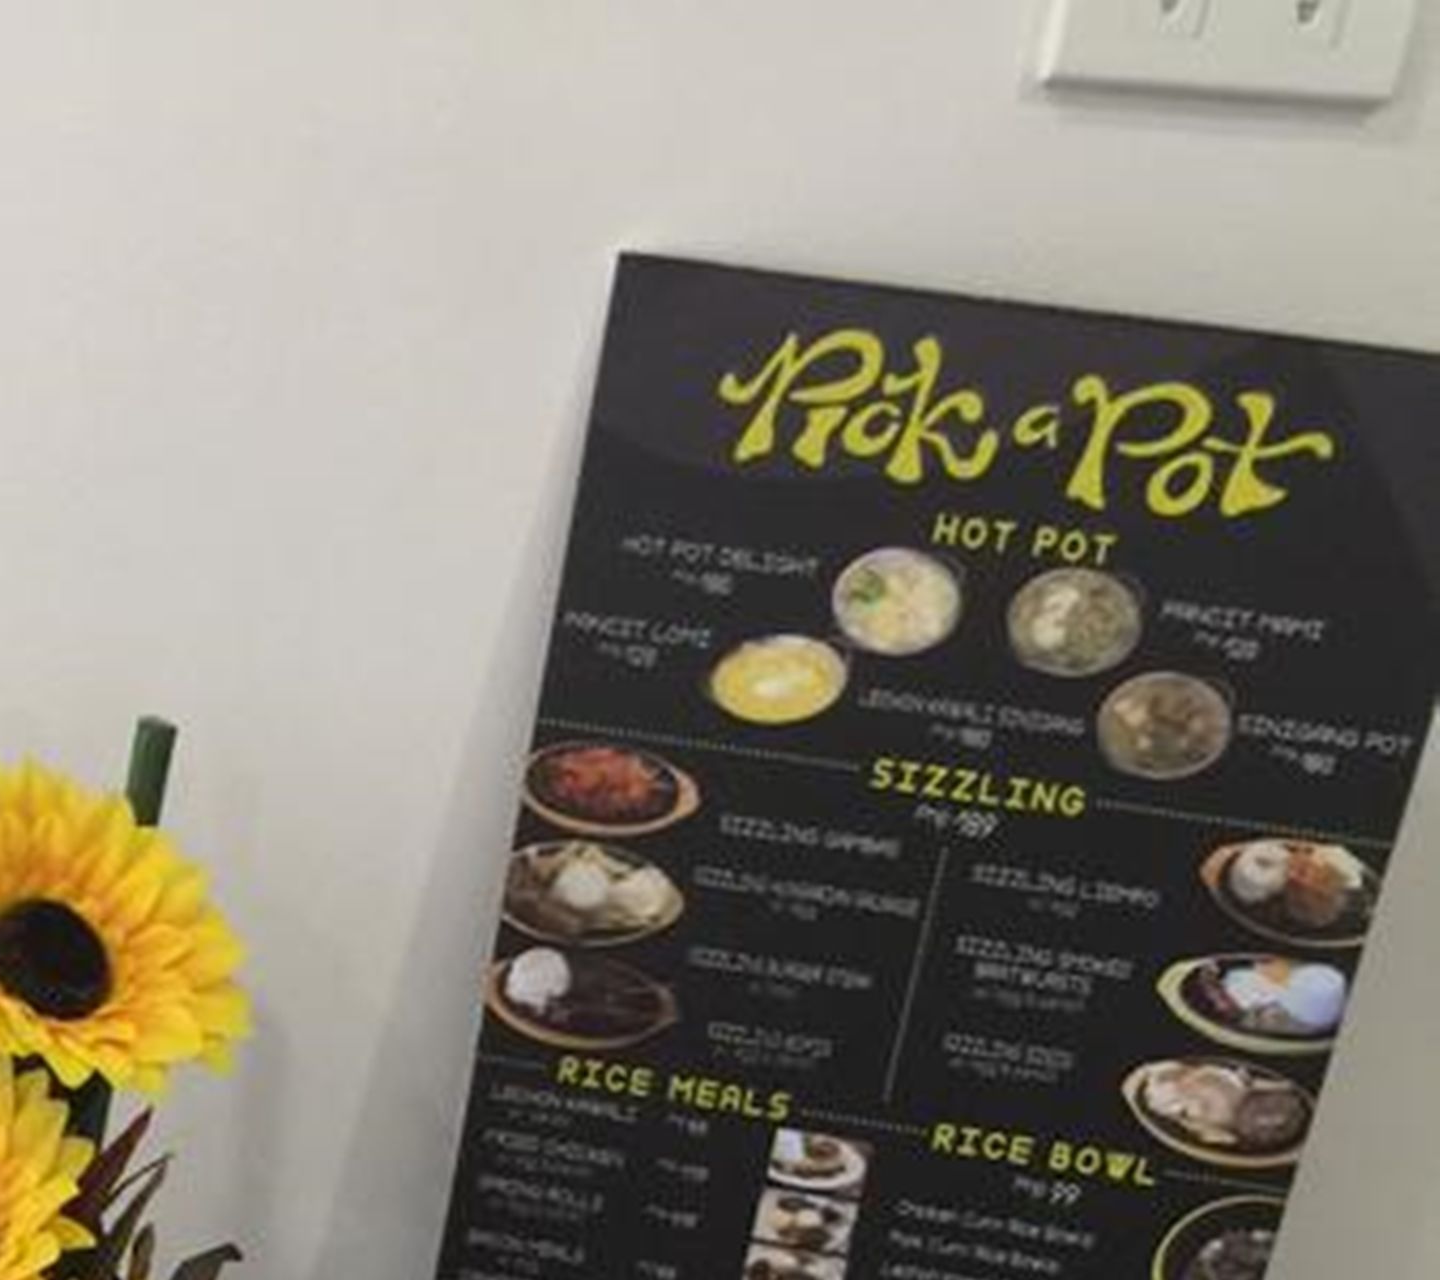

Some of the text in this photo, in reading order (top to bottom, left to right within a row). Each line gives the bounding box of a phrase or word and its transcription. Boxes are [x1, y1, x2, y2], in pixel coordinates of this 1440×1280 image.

[720, 329, 1334, 517] Pick a Pot
[932, 512, 1119, 565] HOT POT
[871, 757, 1086, 815] SIZZLING
[557, 1056, 792, 1121] RICE MEALS
[931, 1123, 1156, 1186] RICE BOWL
